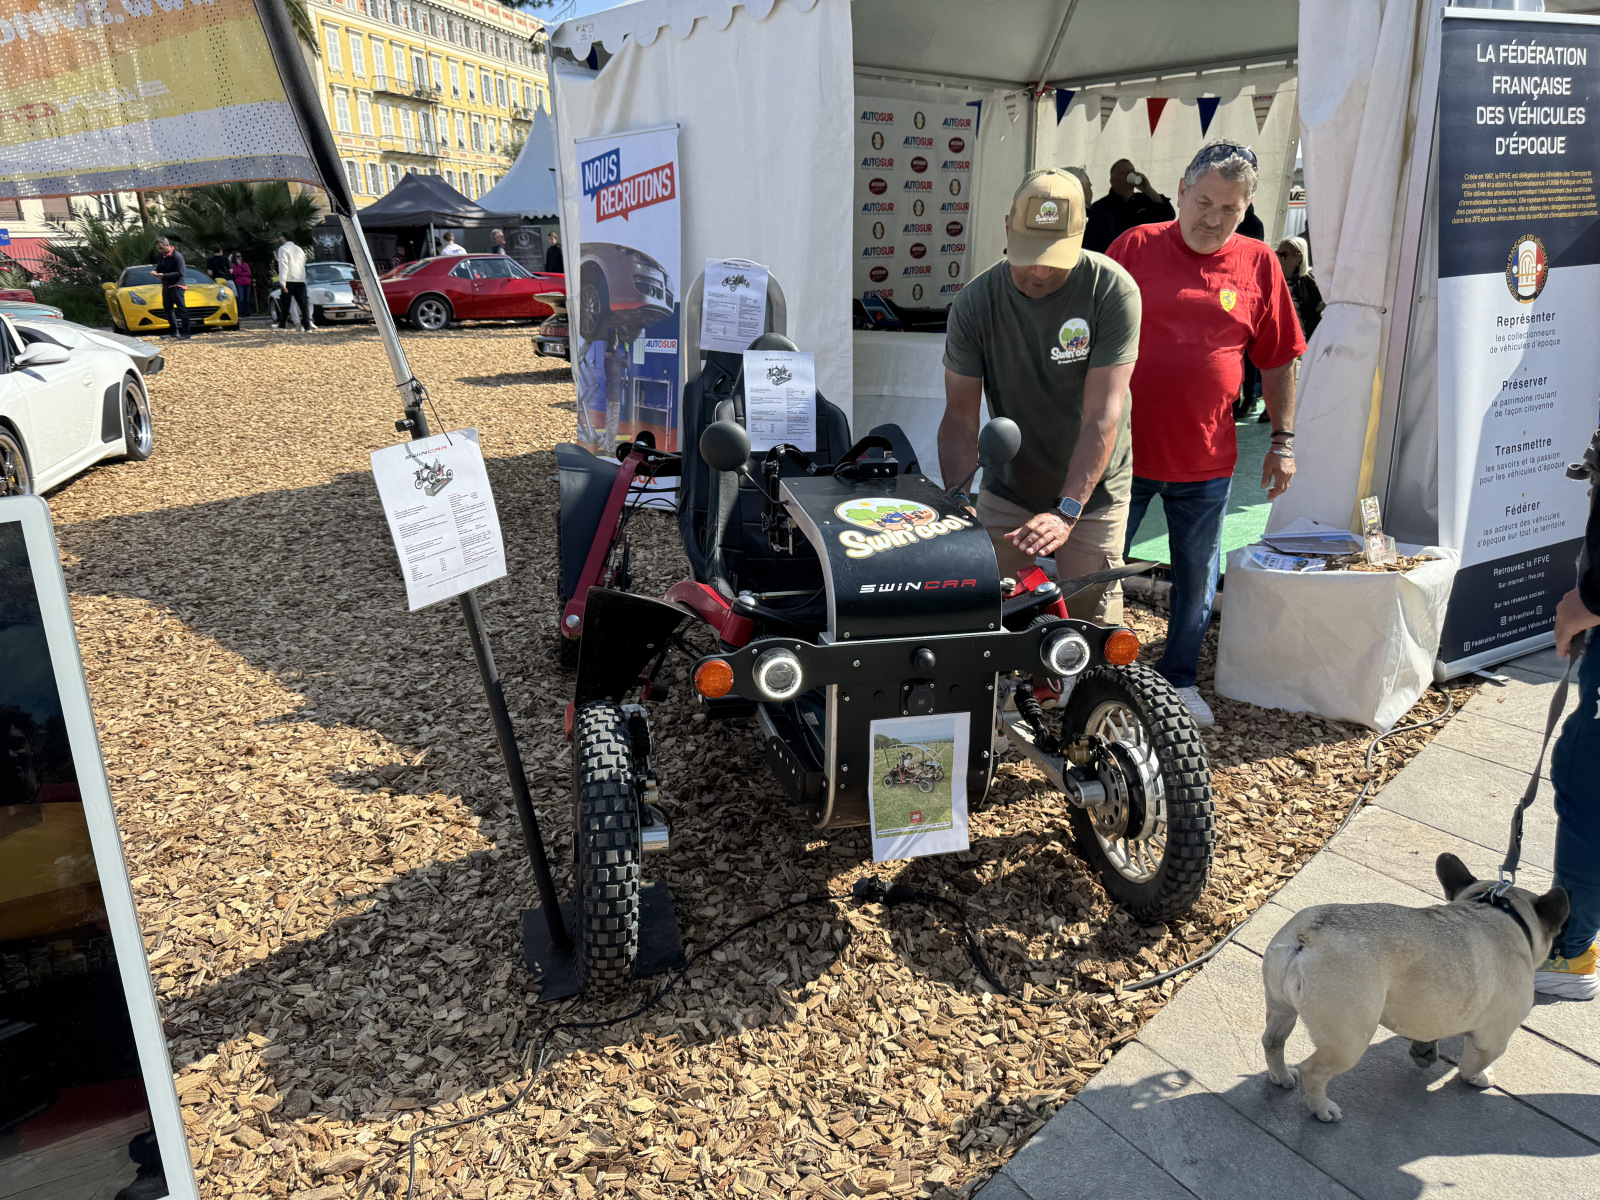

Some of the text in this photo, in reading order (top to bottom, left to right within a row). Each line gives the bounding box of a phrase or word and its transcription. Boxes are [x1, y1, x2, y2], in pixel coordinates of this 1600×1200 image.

[1476, 39, 1586, 66] LA FÉDÉRATION
[1492, 76, 1572, 100] FRANÇAISE
[861, 111, 894, 122] AUTOSUR
[1476, 101, 1586, 124] DES VÉHICULES
[942, 117, 972, 127] AUTOSUR
[903, 136, 934, 146] AUTOSUR
[1496, 131, 1566, 155] D'ÉPOQUE
[862, 158, 894, 167] AUTOSUR
[942, 160, 970, 170] AUTOSUR
[585, 154, 617, 190] NOUS
[600, 168, 671, 216] RECRUTONS
[904, 180, 932, 190] AUTOSUR
[862, 202, 894, 212] AUTOSUR
[940, 202, 970, 212] AUTOSUR
[903, 224, 932, 232] AUTOSUR
[862, 246, 894, 256] AUTOSUR
[940, 244, 966, 252] AUTOSU
[902, 266, 931, 275] AUTOSUR
[1497, 312, 1556, 328] Représenter
[1508, 329, 1556, 340] collectionneurs
[646, 340, 676, 348] AUTOSUR
[1500, 342, 1530, 352] véhicules
[1532, 339, 1560, 348] d'époque
[1502, 376, 1548, 391] Préserver
[1500, 395, 1532, 408] patrimoine
[1534, 390, 1556, 400] roulant
[1505, 407, 1522, 416] façon
[1524, 402, 1554, 412] citoyenne
[1496, 438, 1552, 456] Transmettre
[1497, 460, 1520, 470] savoirs
[1536, 452, 1560, 464] passion
[1480, 476, 1494, 486] pour
[1508, 466, 1536, 478] véhicules
[1538, 461, 1564, 472] d'époque
[1506, 501, 1540, 516] Fédérer
[1484, 512, 1560, 536] les acteurs des véhicules
[839, 514, 973, 558] Swin'cool
[1476, 535, 1506, 548] d'époque
[1508, 532, 1518, 540] sur
[1520, 528, 1530, 537] tout
[1540, 520, 1566, 532] territoire
[1494, 563, 1524, 576] Retrouvez
[1534, 554, 1550, 566] FFVE
[1472, 636, 1496, 647] Fédération
[1496, 628, 1518, 640] Française
